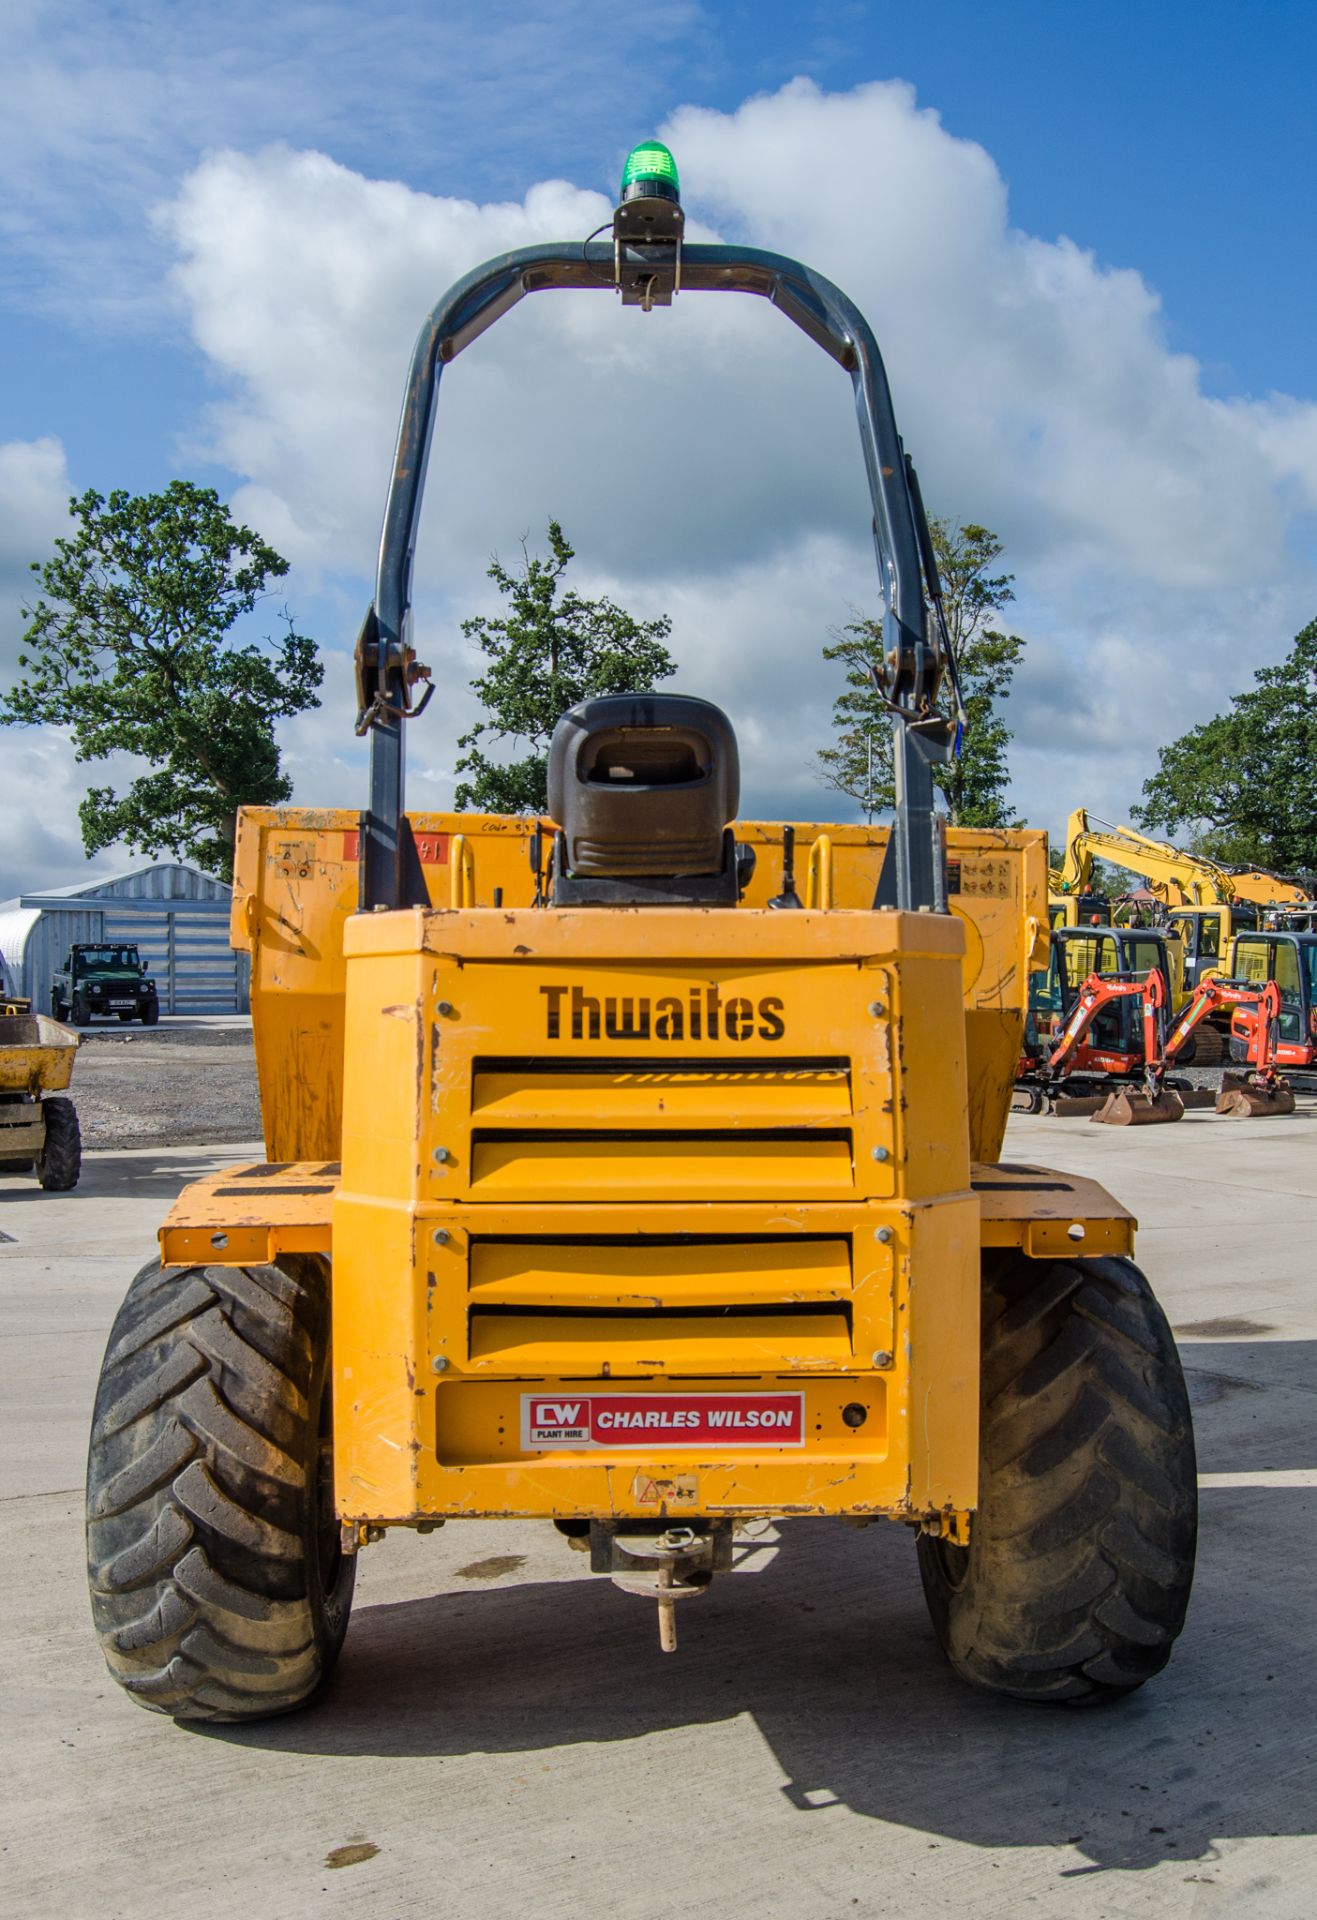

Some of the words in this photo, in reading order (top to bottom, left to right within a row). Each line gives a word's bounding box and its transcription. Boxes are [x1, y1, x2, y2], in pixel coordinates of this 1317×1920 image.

[539, 985, 786, 1041] Thwaites
[536, 1403, 582, 1426] CW
[597, 1411, 701, 1429] CHARLES
[707, 1410, 794, 1428] WILSON
[537, 1430, 562, 1438] PLANT
[565, 1430, 583, 1438] HIRE
